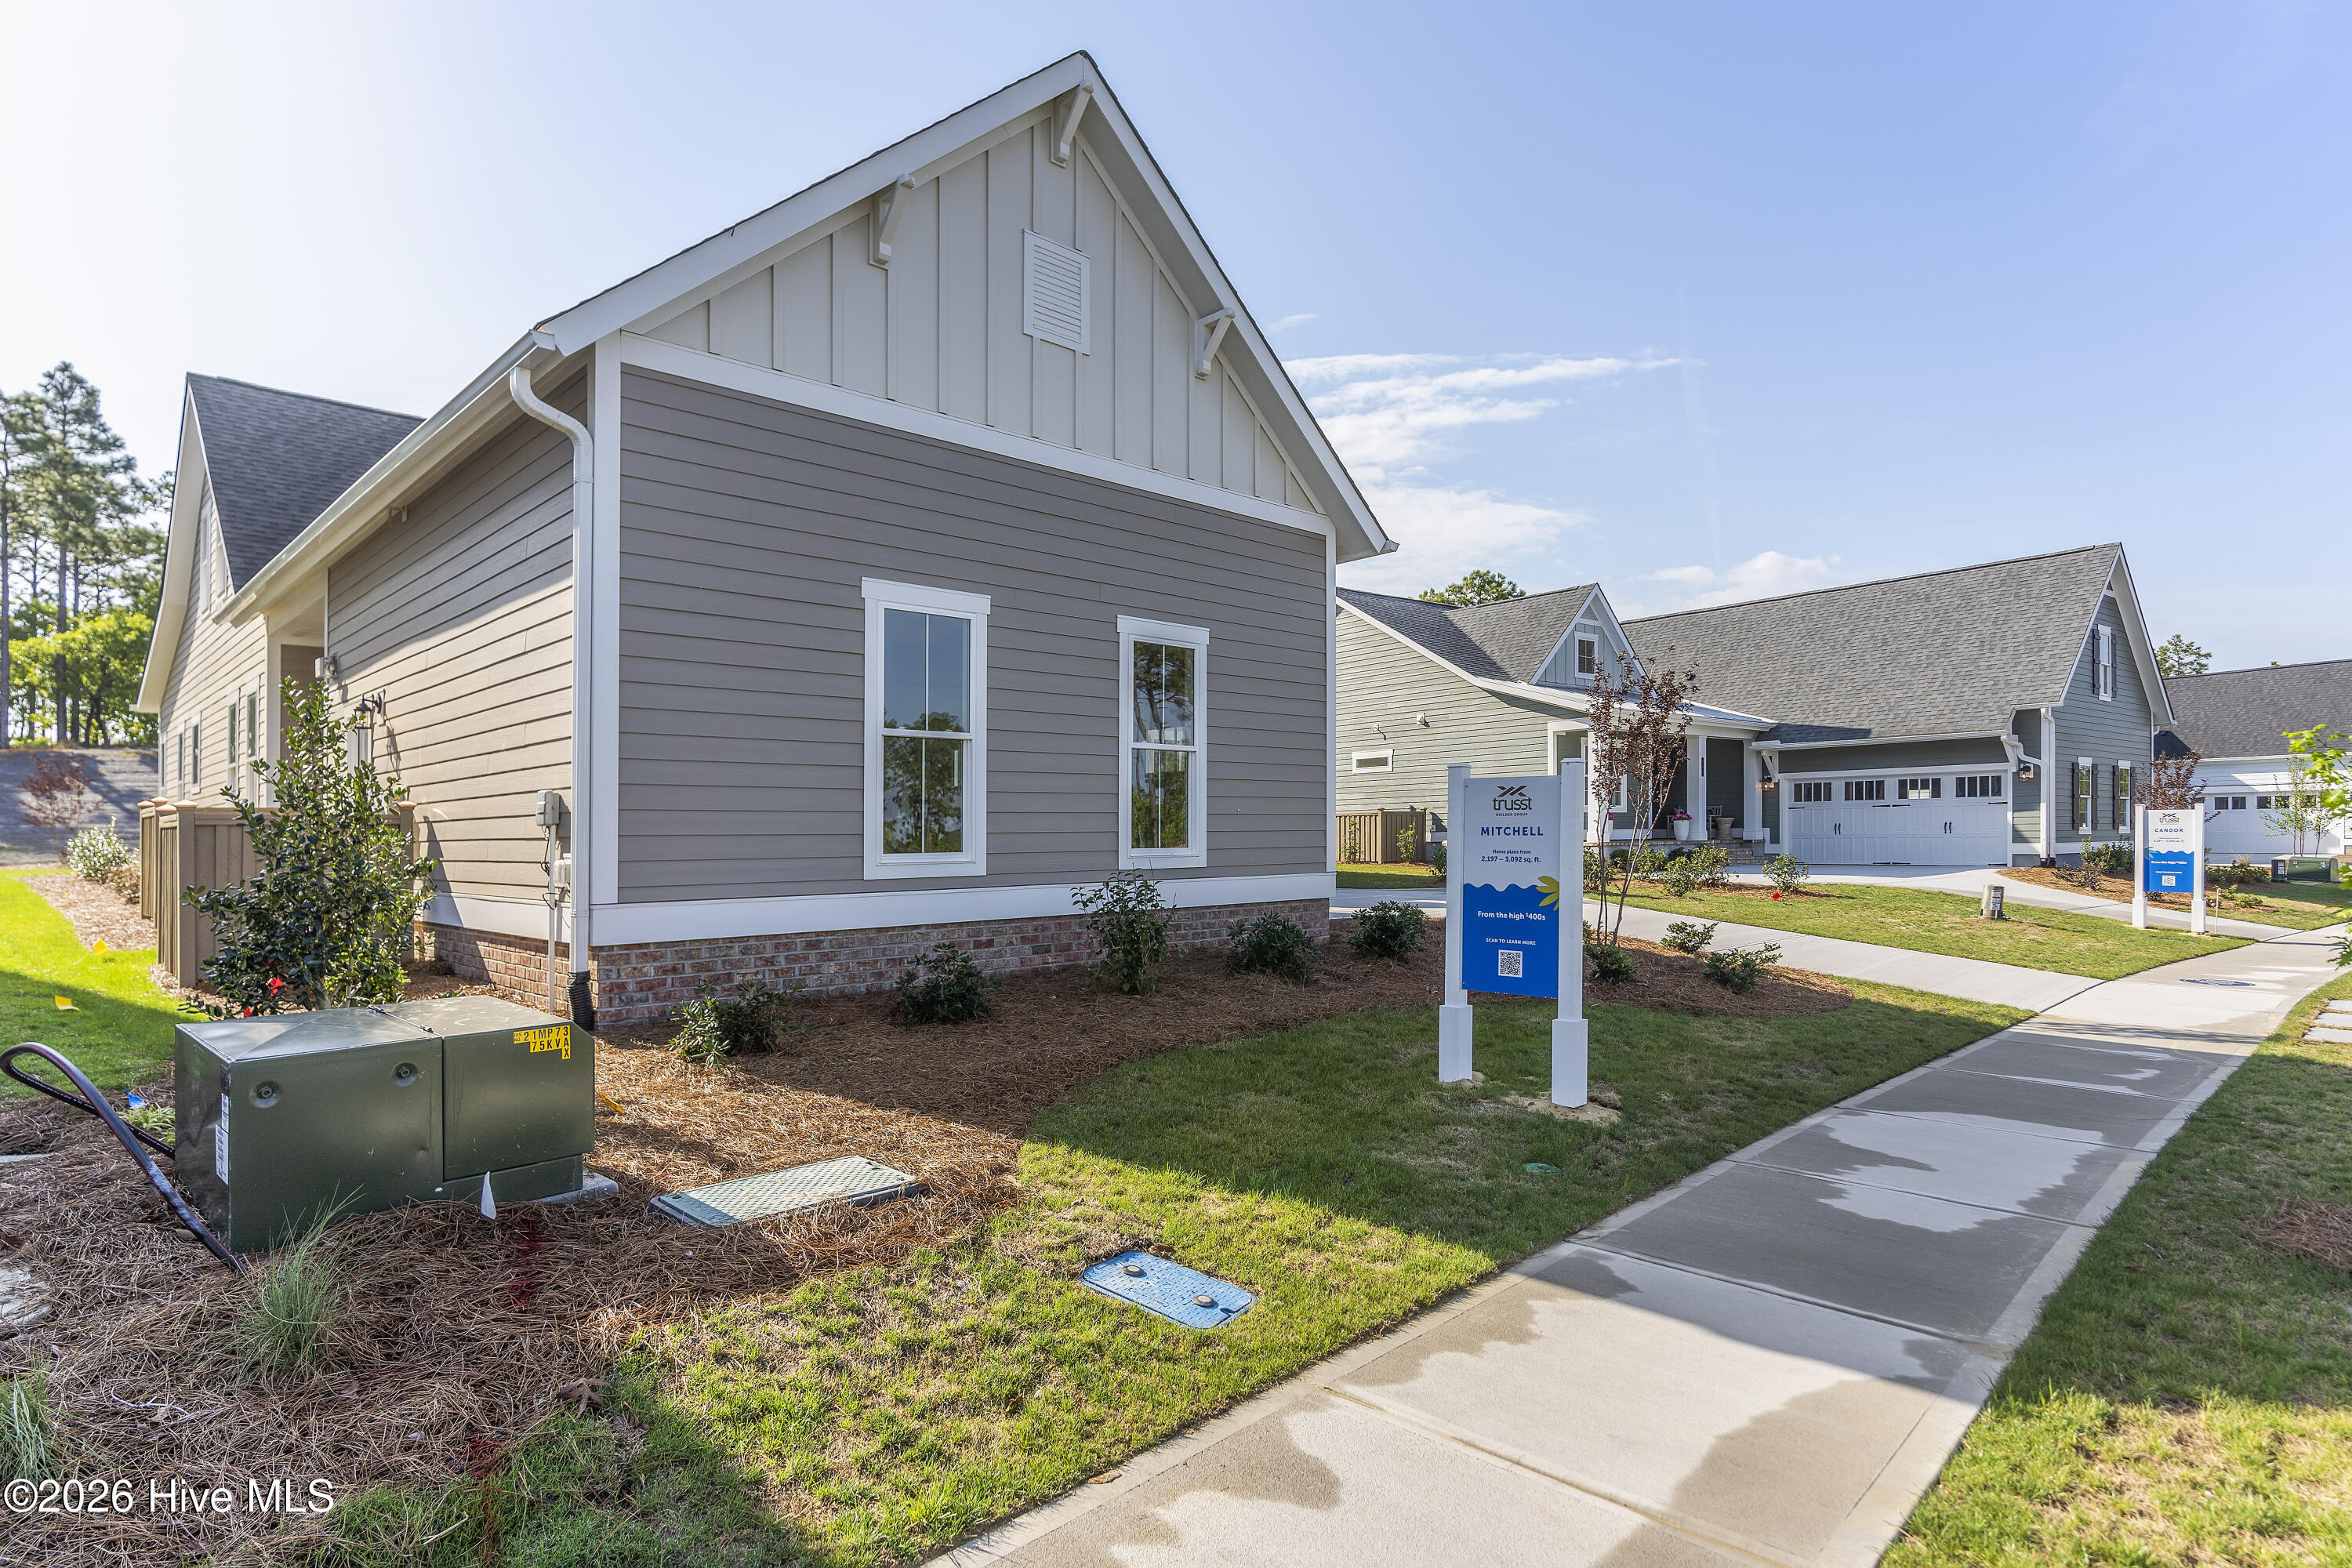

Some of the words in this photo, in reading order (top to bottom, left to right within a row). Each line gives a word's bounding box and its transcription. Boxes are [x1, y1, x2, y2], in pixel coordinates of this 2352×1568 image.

[1493, 797, 1532, 811] trusst
[1481, 827, 1543, 836] MITCHELL
[564, 1048, 569, 1058] X
